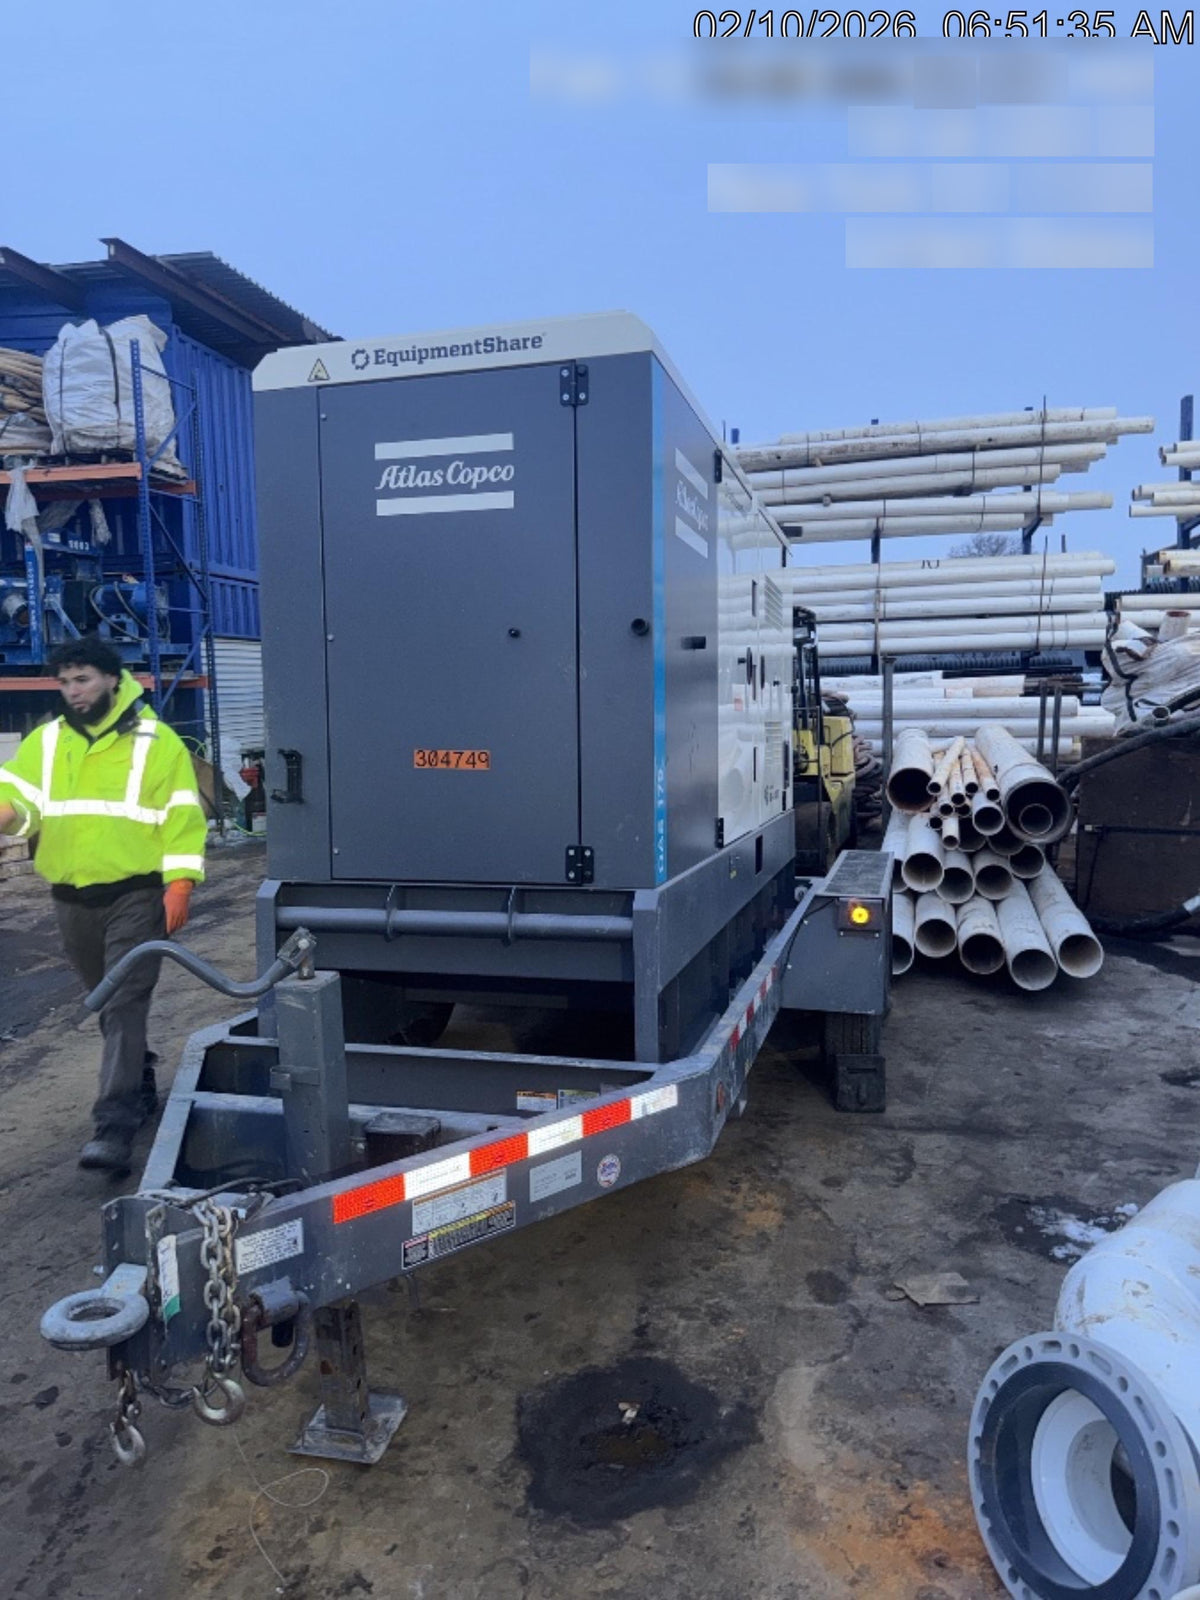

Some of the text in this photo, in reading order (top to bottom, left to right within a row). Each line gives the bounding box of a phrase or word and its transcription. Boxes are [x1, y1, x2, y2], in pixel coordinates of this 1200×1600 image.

[373, 334, 543, 368] EquipmentShare
[374, 459, 515, 490] Atlas Copco
[414, 749, 490, 769] 304749
